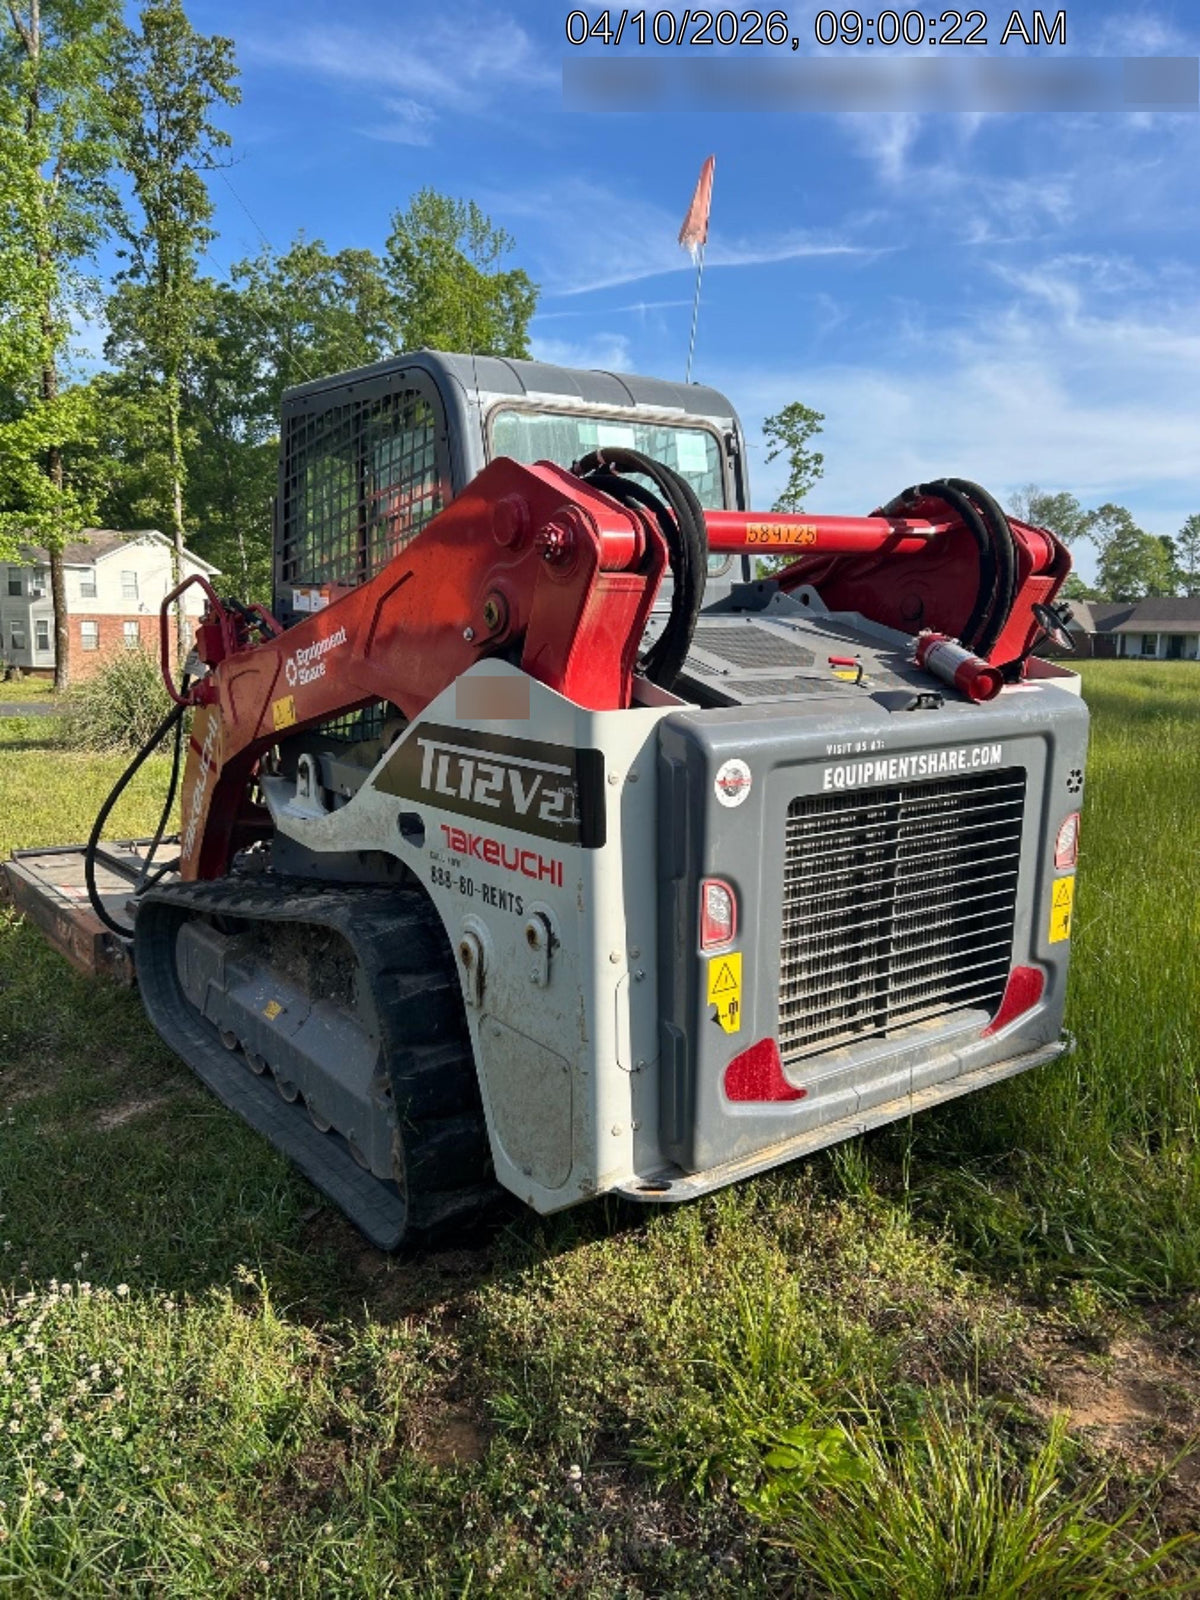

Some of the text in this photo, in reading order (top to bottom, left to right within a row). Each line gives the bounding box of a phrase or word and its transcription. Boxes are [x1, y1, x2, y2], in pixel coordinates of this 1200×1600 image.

[296, 625, 347, 665] Equipment
[822, 744, 1003, 791] EQUIPMENTSHARE.COM
[825, 742, 852, 756] VISIT
[855, 741, 867, 753] US
